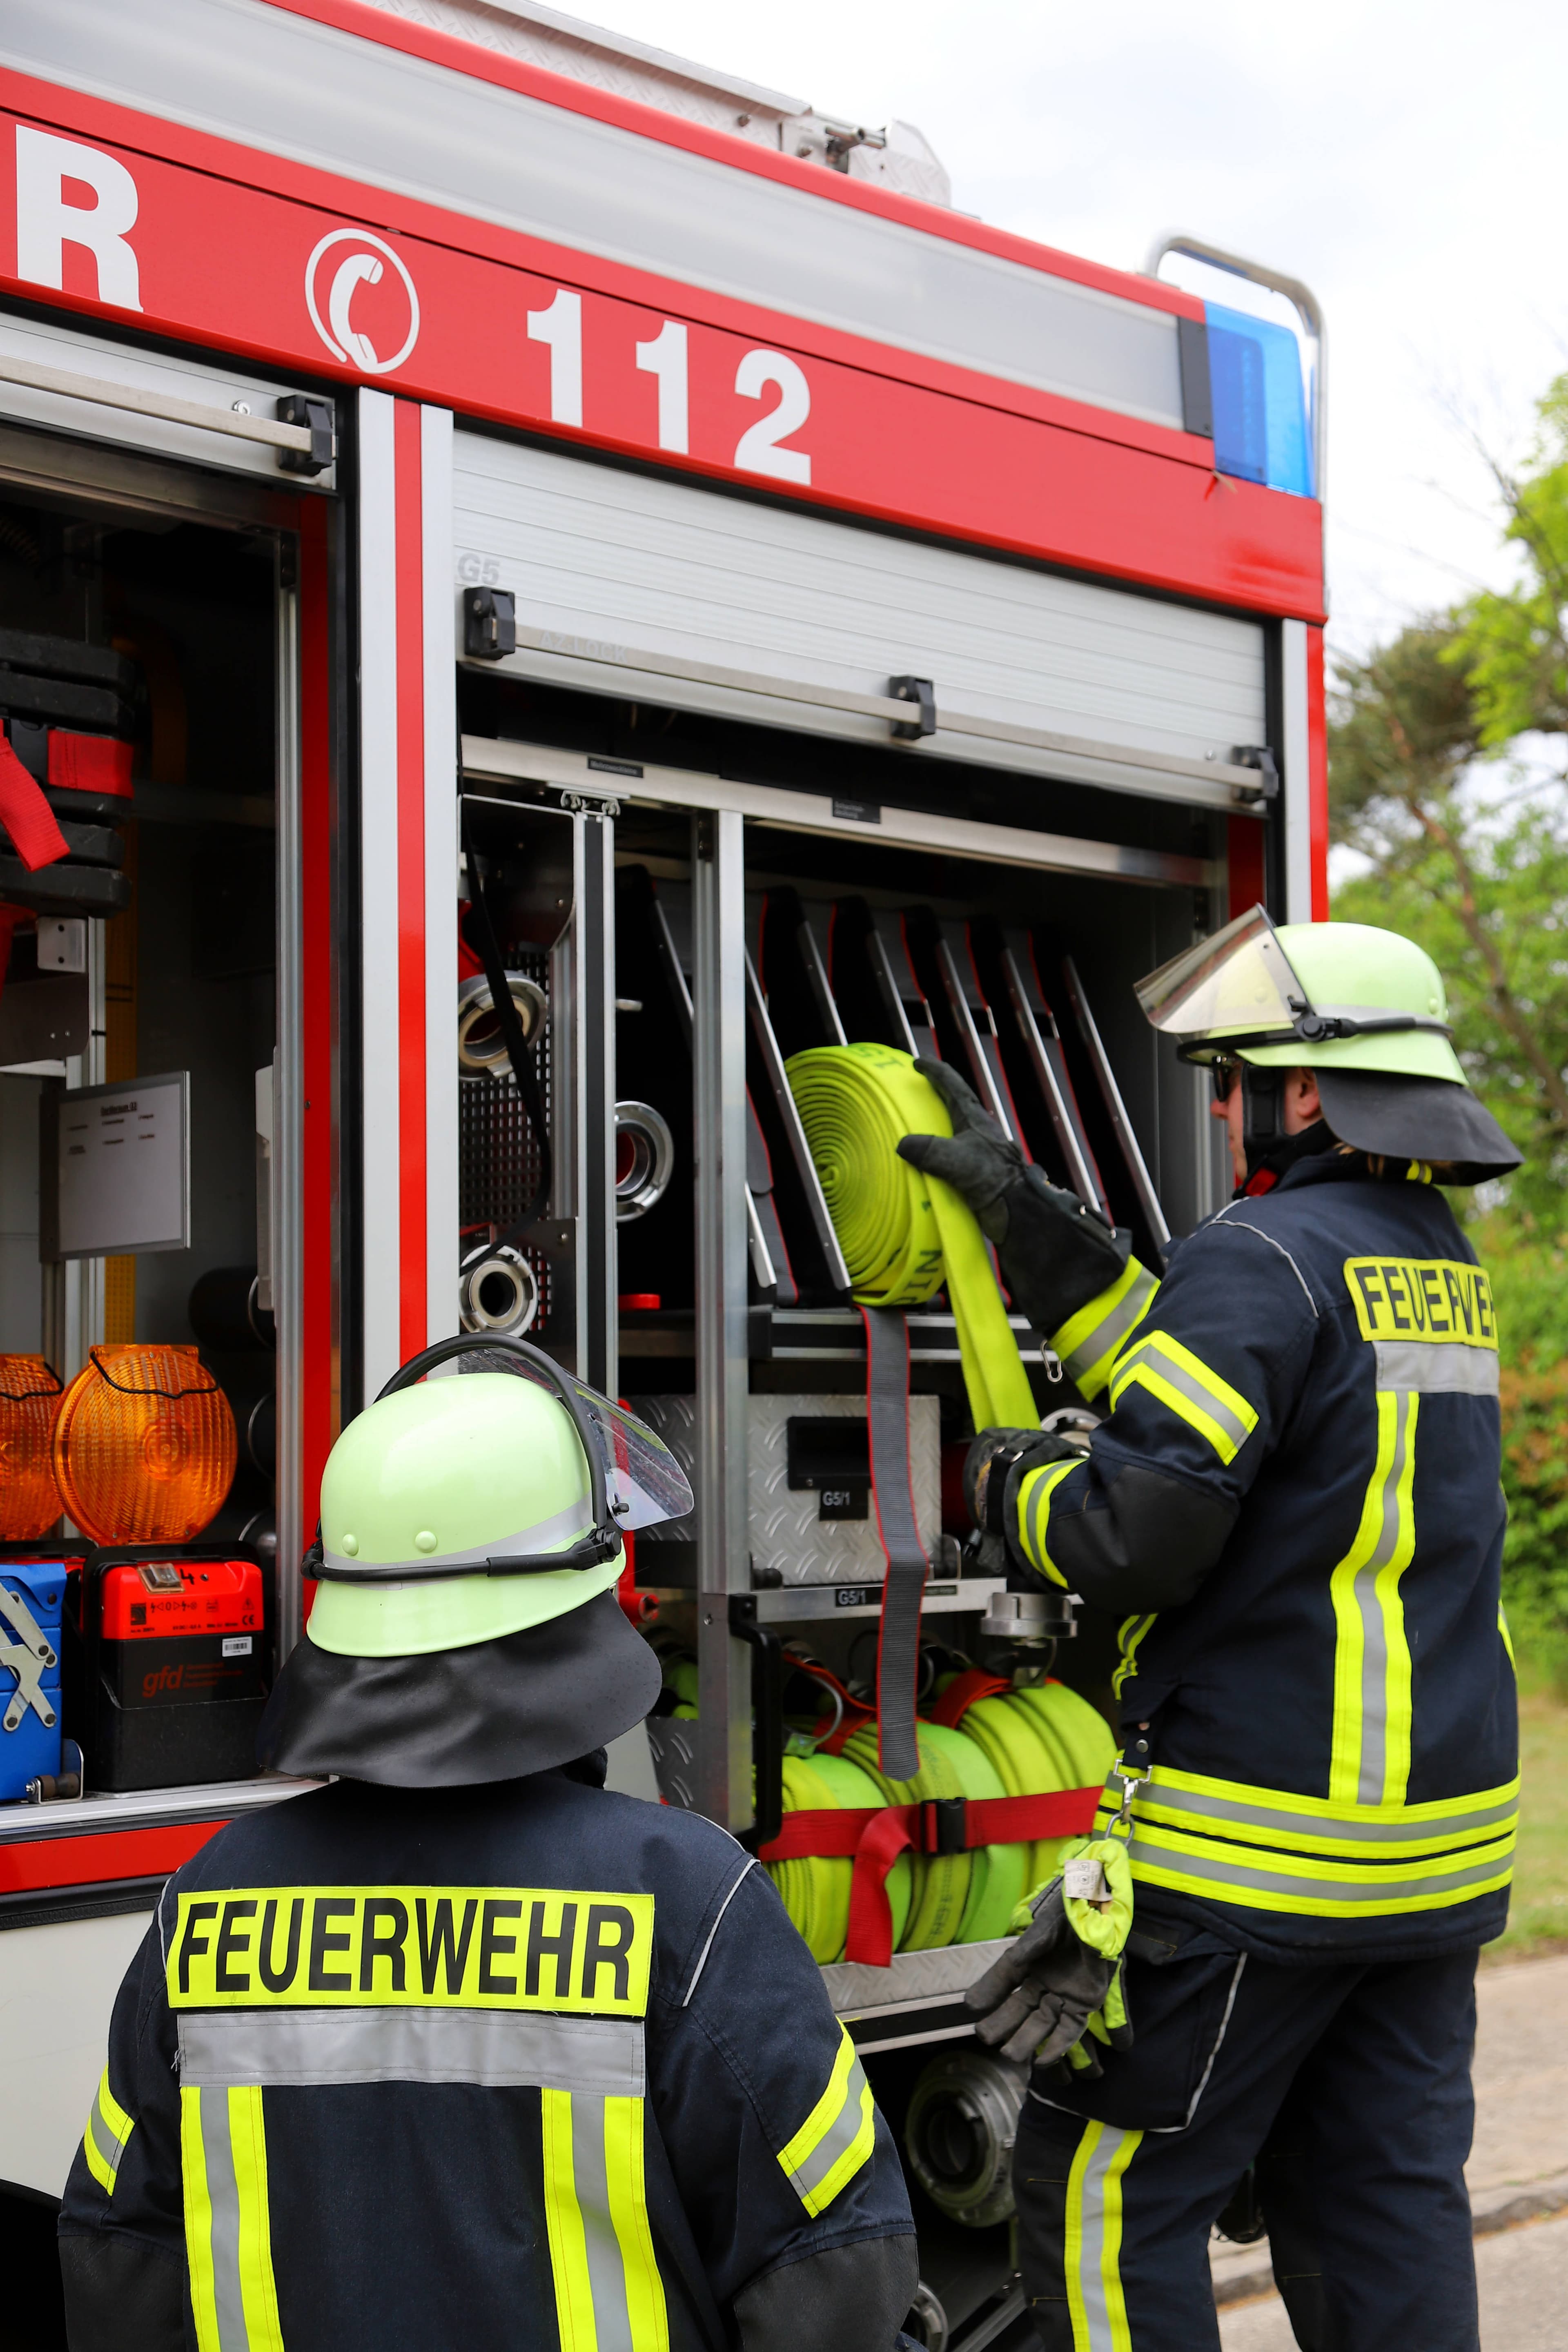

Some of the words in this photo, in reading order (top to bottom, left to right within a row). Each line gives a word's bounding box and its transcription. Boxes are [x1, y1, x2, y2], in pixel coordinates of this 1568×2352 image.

[15, 123, 144, 313] R
[527, 287, 812, 485] 112
[457, 552, 500, 586] G5
[822, 1490, 851, 1506] G5/1
[180, 1568, 195, 1585] 4
[838, 1590, 866, 1605] G5/1
[142, 1664, 184, 1698] gfd
[178, 1897, 635, 2001] FEUERWEHR
